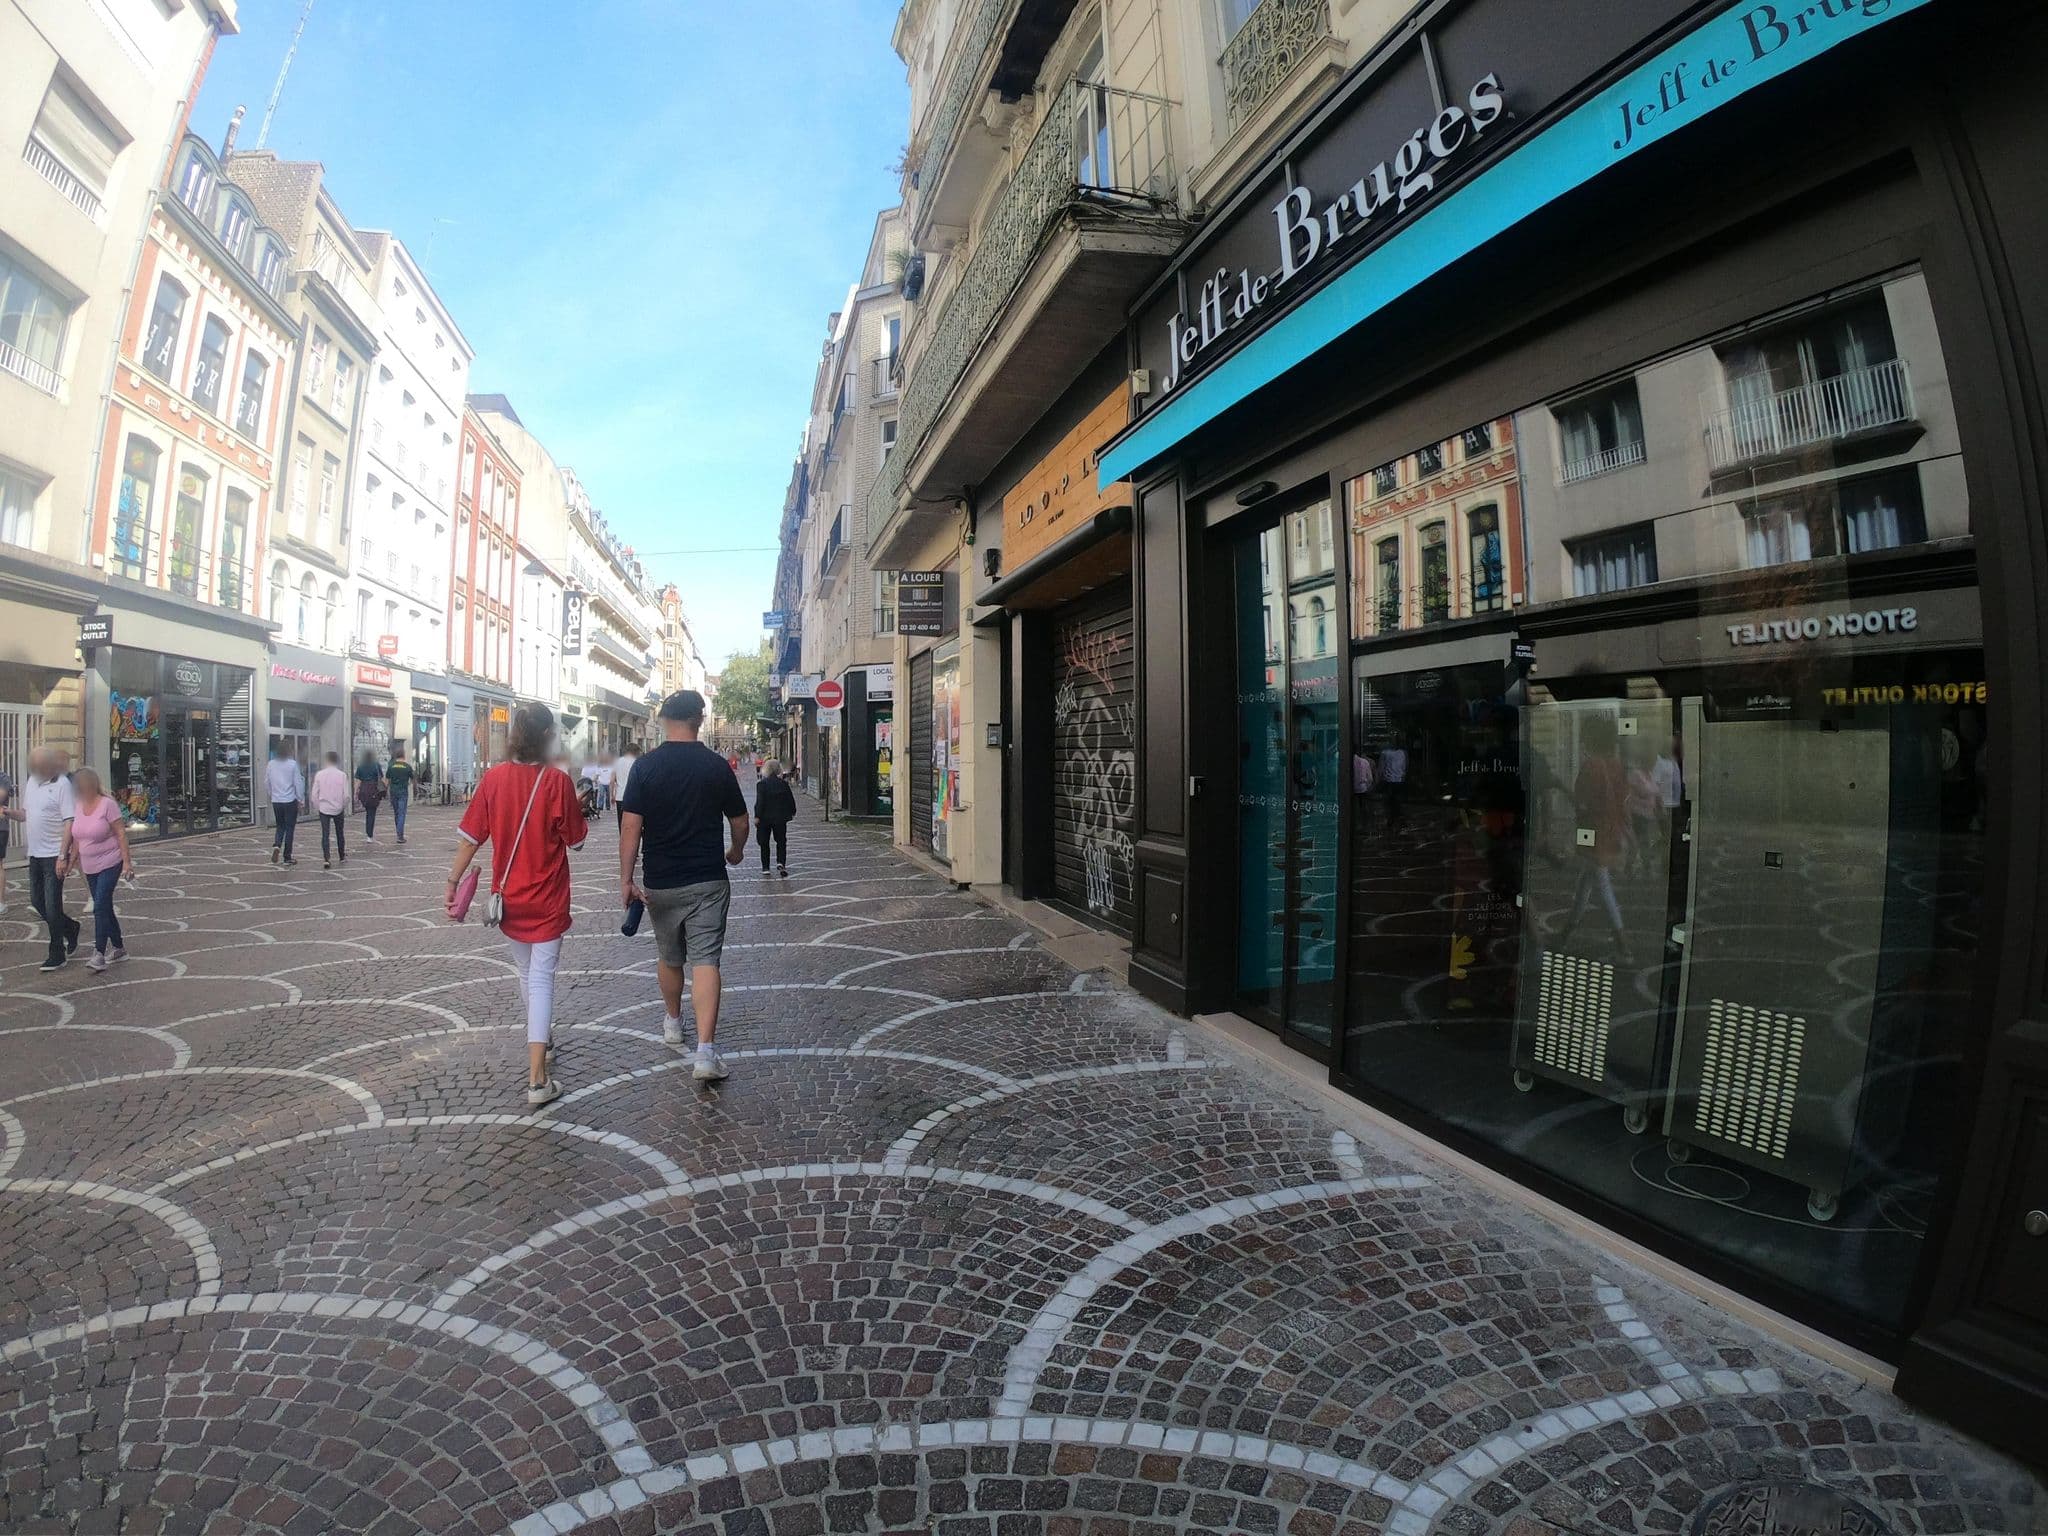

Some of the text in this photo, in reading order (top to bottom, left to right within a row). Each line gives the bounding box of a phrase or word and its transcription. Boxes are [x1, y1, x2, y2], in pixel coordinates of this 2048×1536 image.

[1613, 62, 1692, 149] Jeff
[1701, 58, 1737, 89] de
[1162, 72, 1504, 393] Jeff de Bruges
[901, 573, 941, 582] A LOUER
[82, 631, 108, 640] OUTLET
[84, 622, 107, 631] STOCK
[563, 597, 581, 649] fnac
